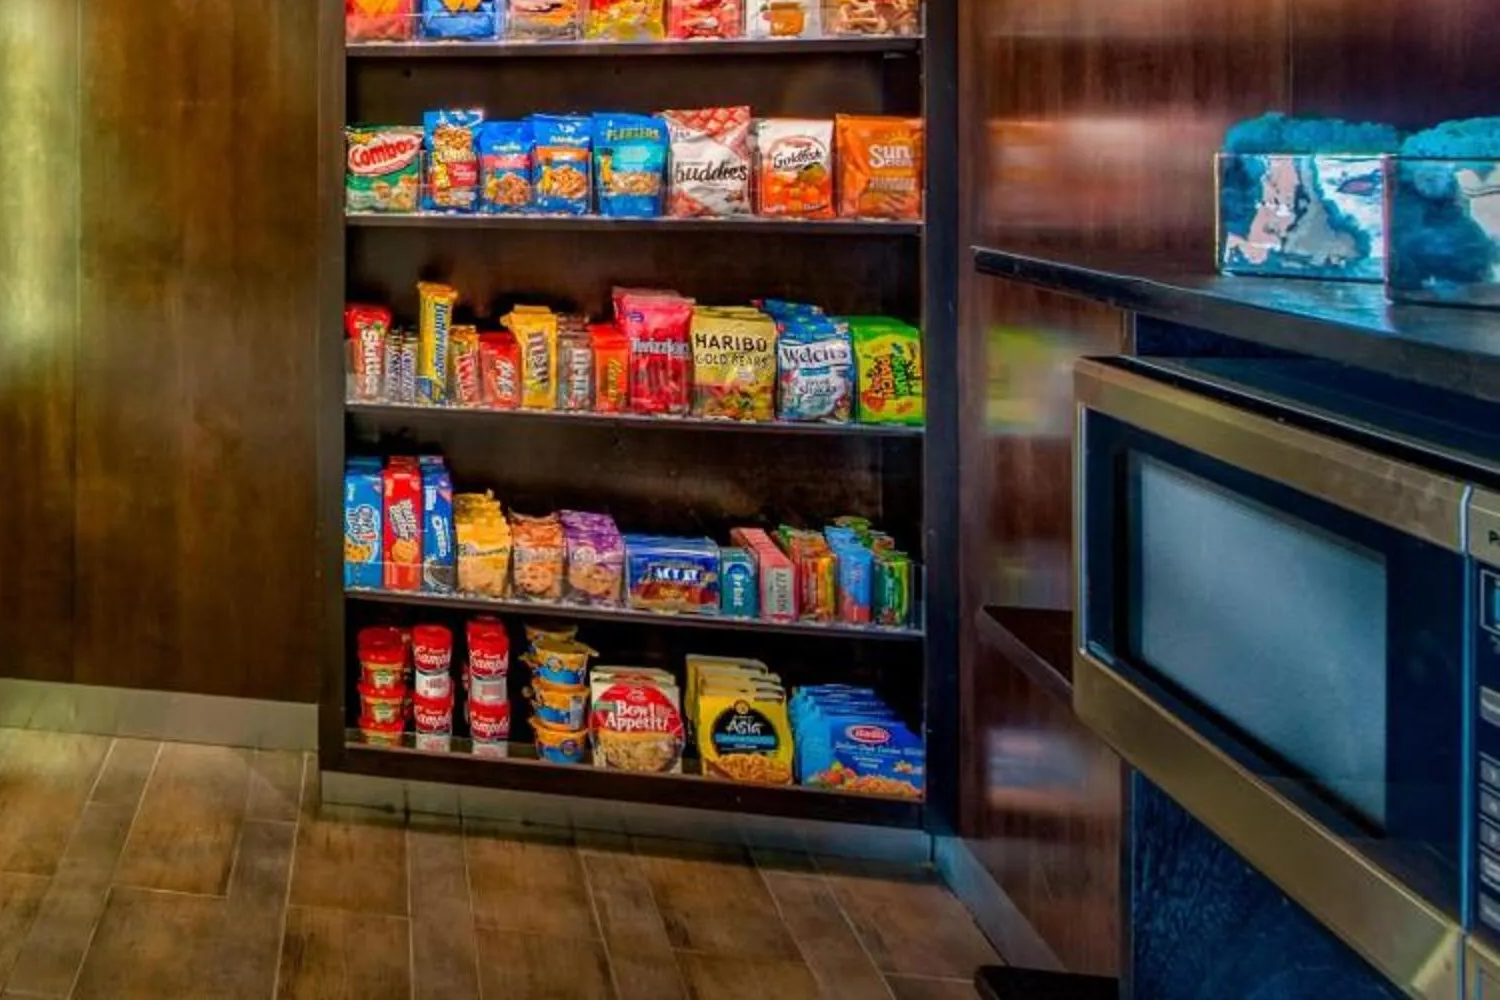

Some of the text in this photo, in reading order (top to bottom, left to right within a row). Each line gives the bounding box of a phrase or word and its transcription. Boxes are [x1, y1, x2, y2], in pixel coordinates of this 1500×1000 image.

[350, 137, 418, 168] Combos
[773, 147, 823, 169] Goldfish
[694, 333, 768, 352] HARIBO
[361, 328, 381, 395] Skittles
[616, 699, 656, 717] Bowl
